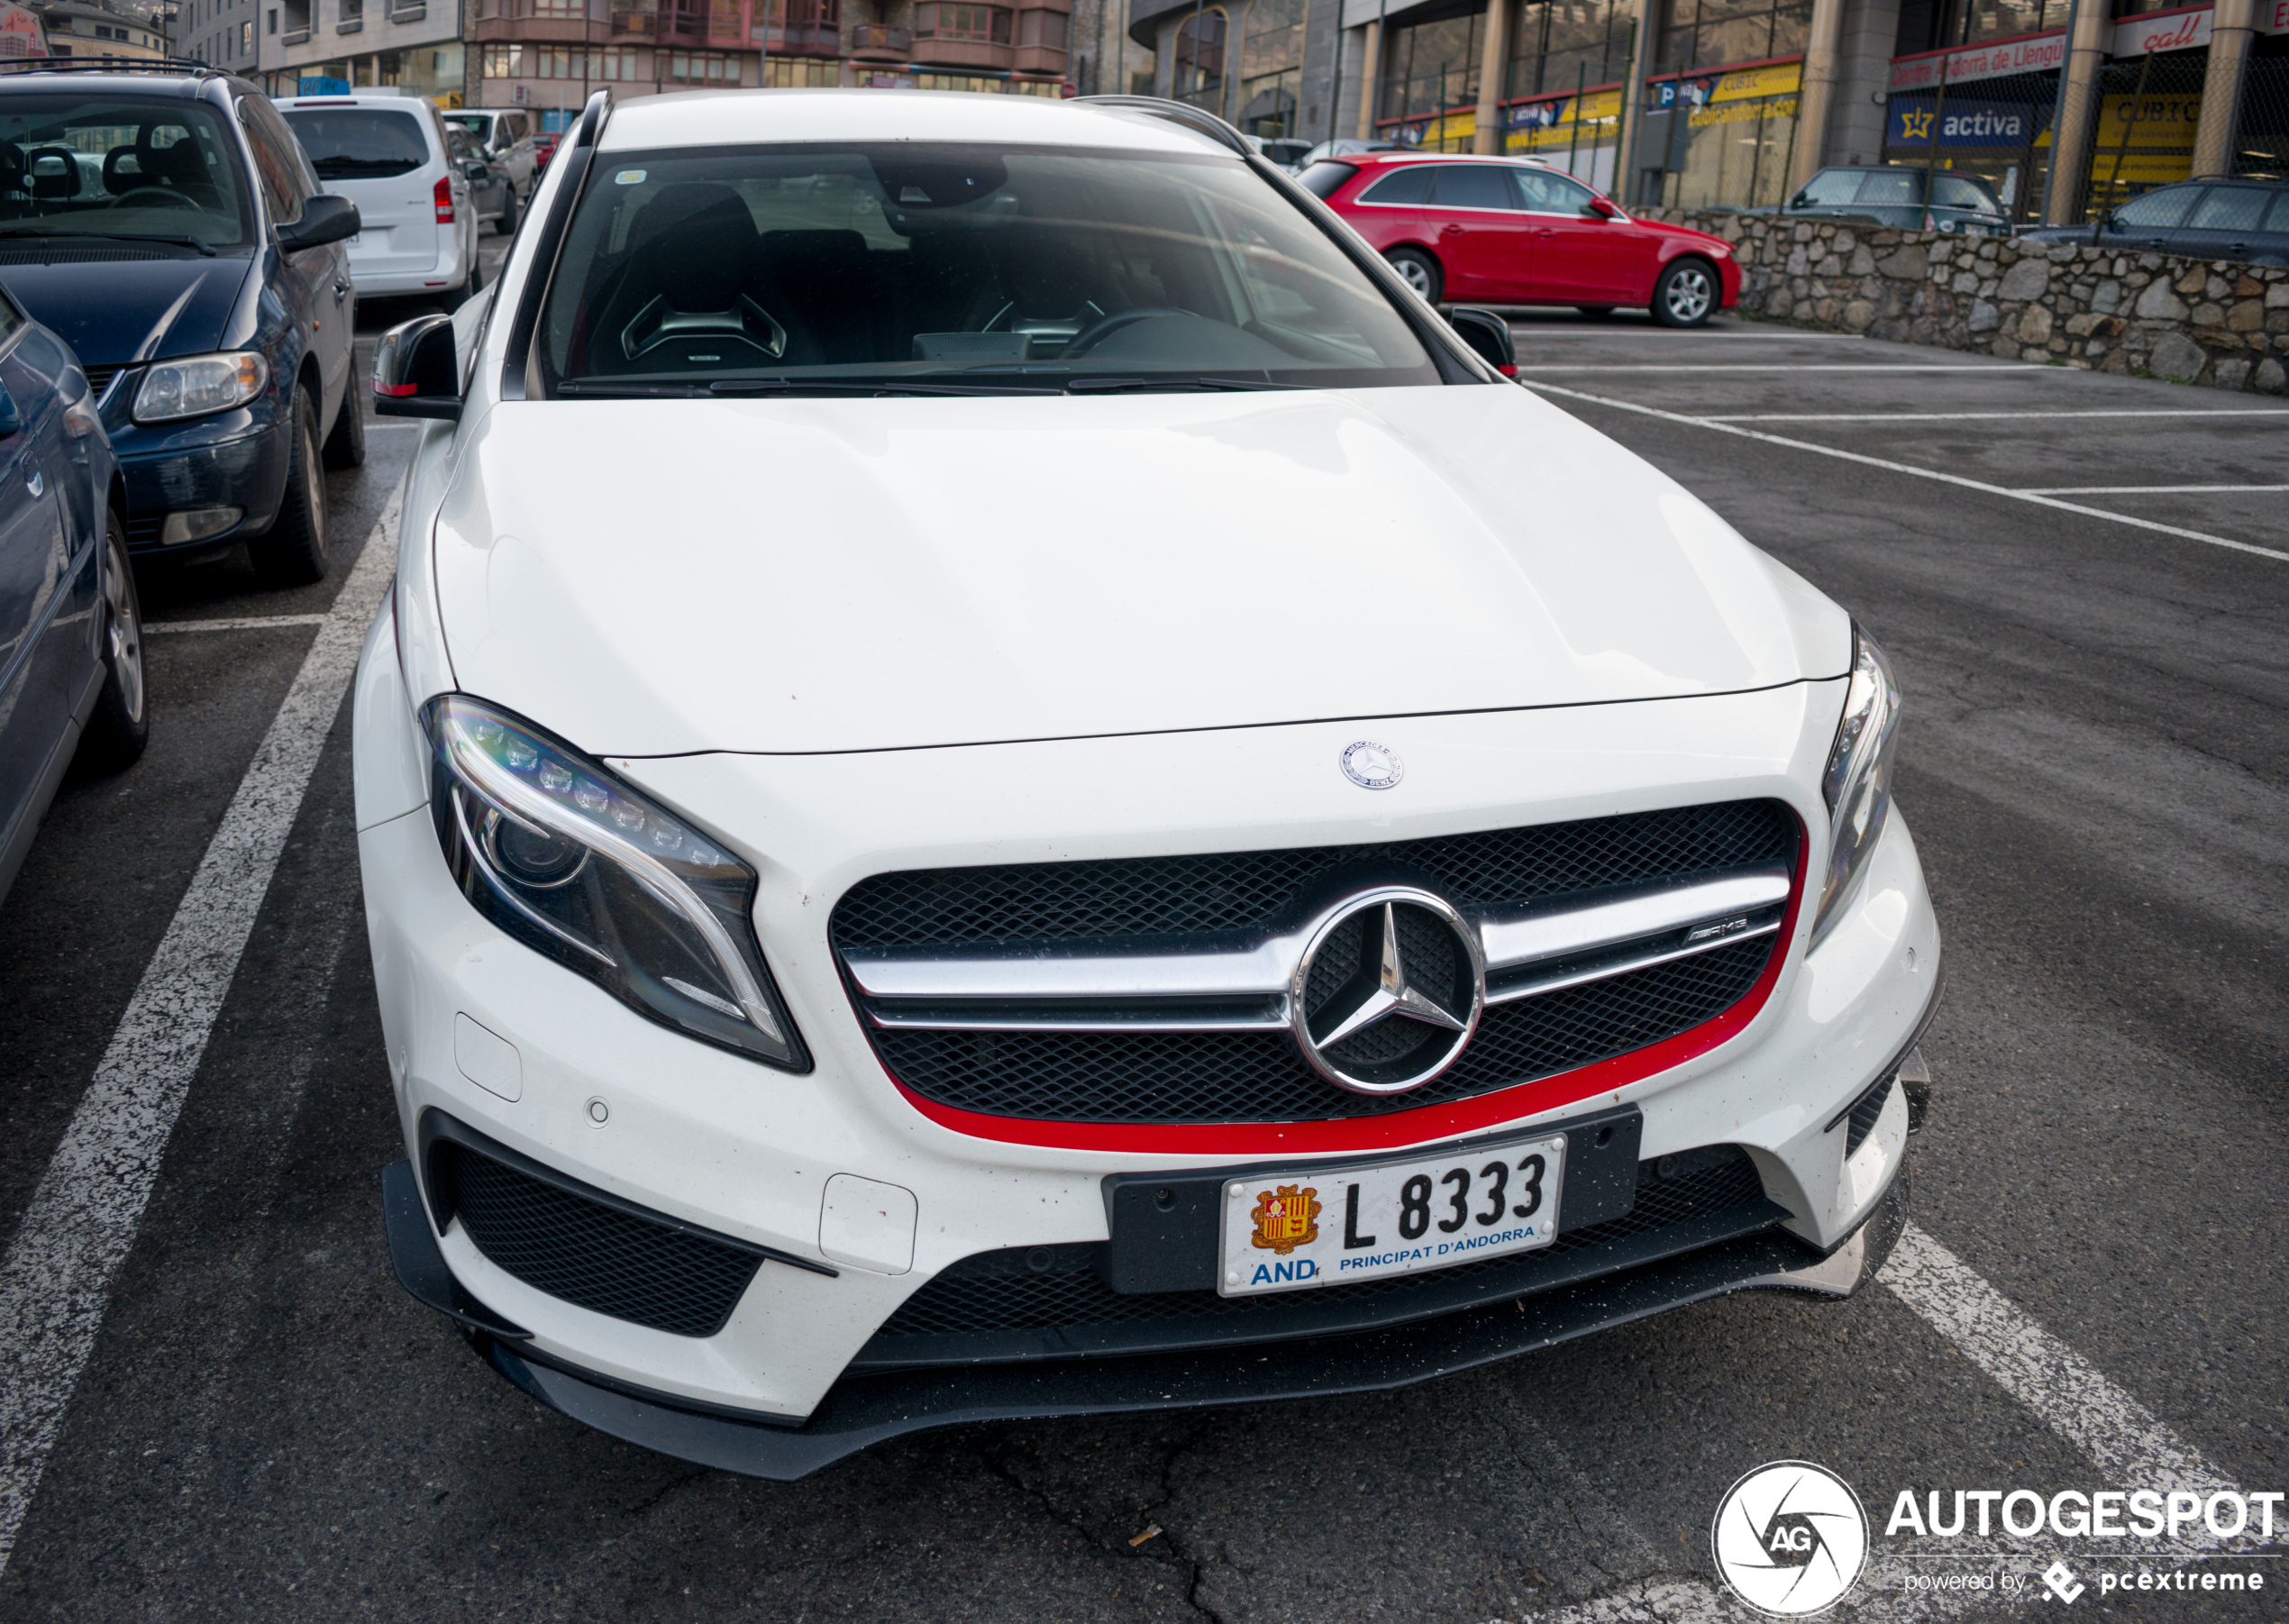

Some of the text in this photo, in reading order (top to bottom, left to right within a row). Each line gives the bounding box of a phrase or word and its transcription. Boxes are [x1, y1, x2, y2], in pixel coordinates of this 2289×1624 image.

[2274, 3, 2289, 28] E
[2144, 14, 2202, 50] call
[1993, 49, 2010, 70] de
[1662, 87, 1674, 105] P
[1943, 110, 2021, 136] activa
[1344, 1154, 1546, 1250] L 8333
[1340, 1246, 1432, 1271] PRINCIPAT
[1251, 1259, 1316, 1286] AND
